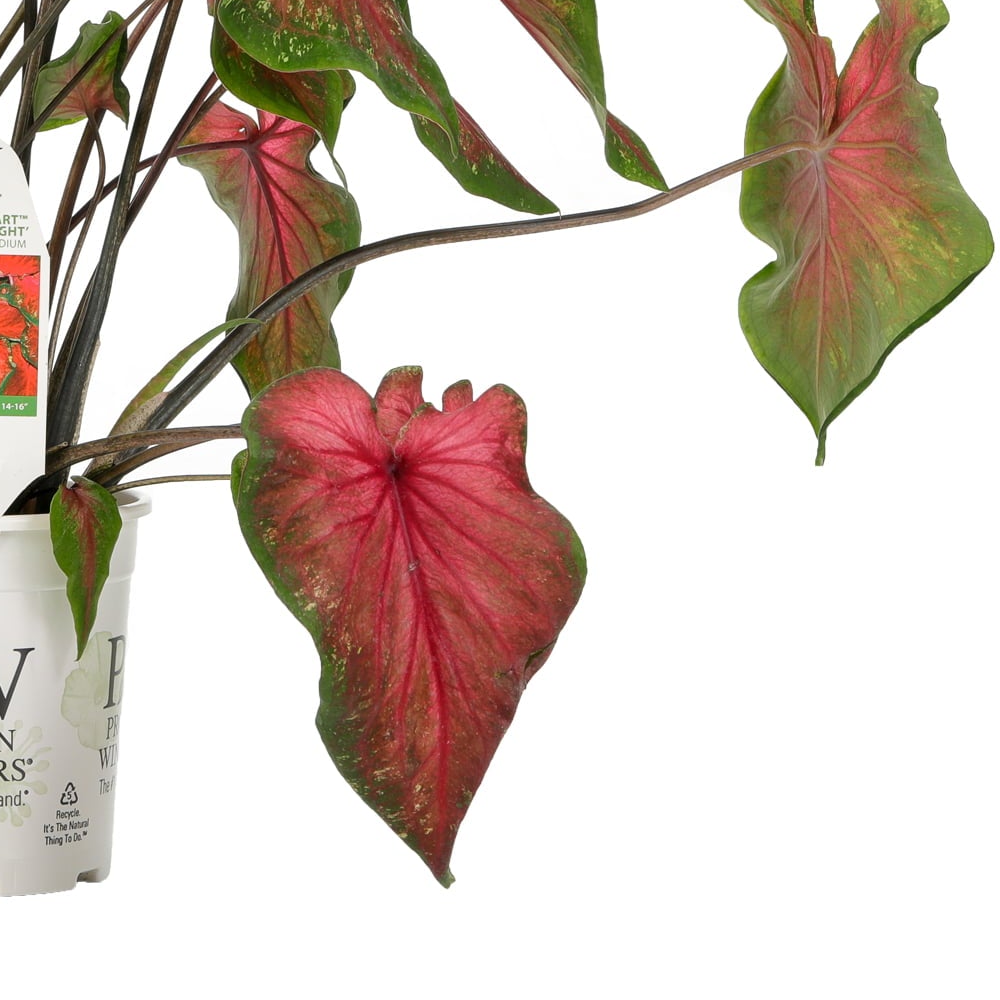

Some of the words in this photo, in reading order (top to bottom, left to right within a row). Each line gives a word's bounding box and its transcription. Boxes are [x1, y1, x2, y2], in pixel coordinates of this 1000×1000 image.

[56, 808, 80, 820] Recycle.
[43, 823, 55, 834] It's
[56, 822, 68, 832] The
[68, 818, 90, 831] Natural
[45, 835, 63, 846] Thing
[64, 834, 73, 844] To
